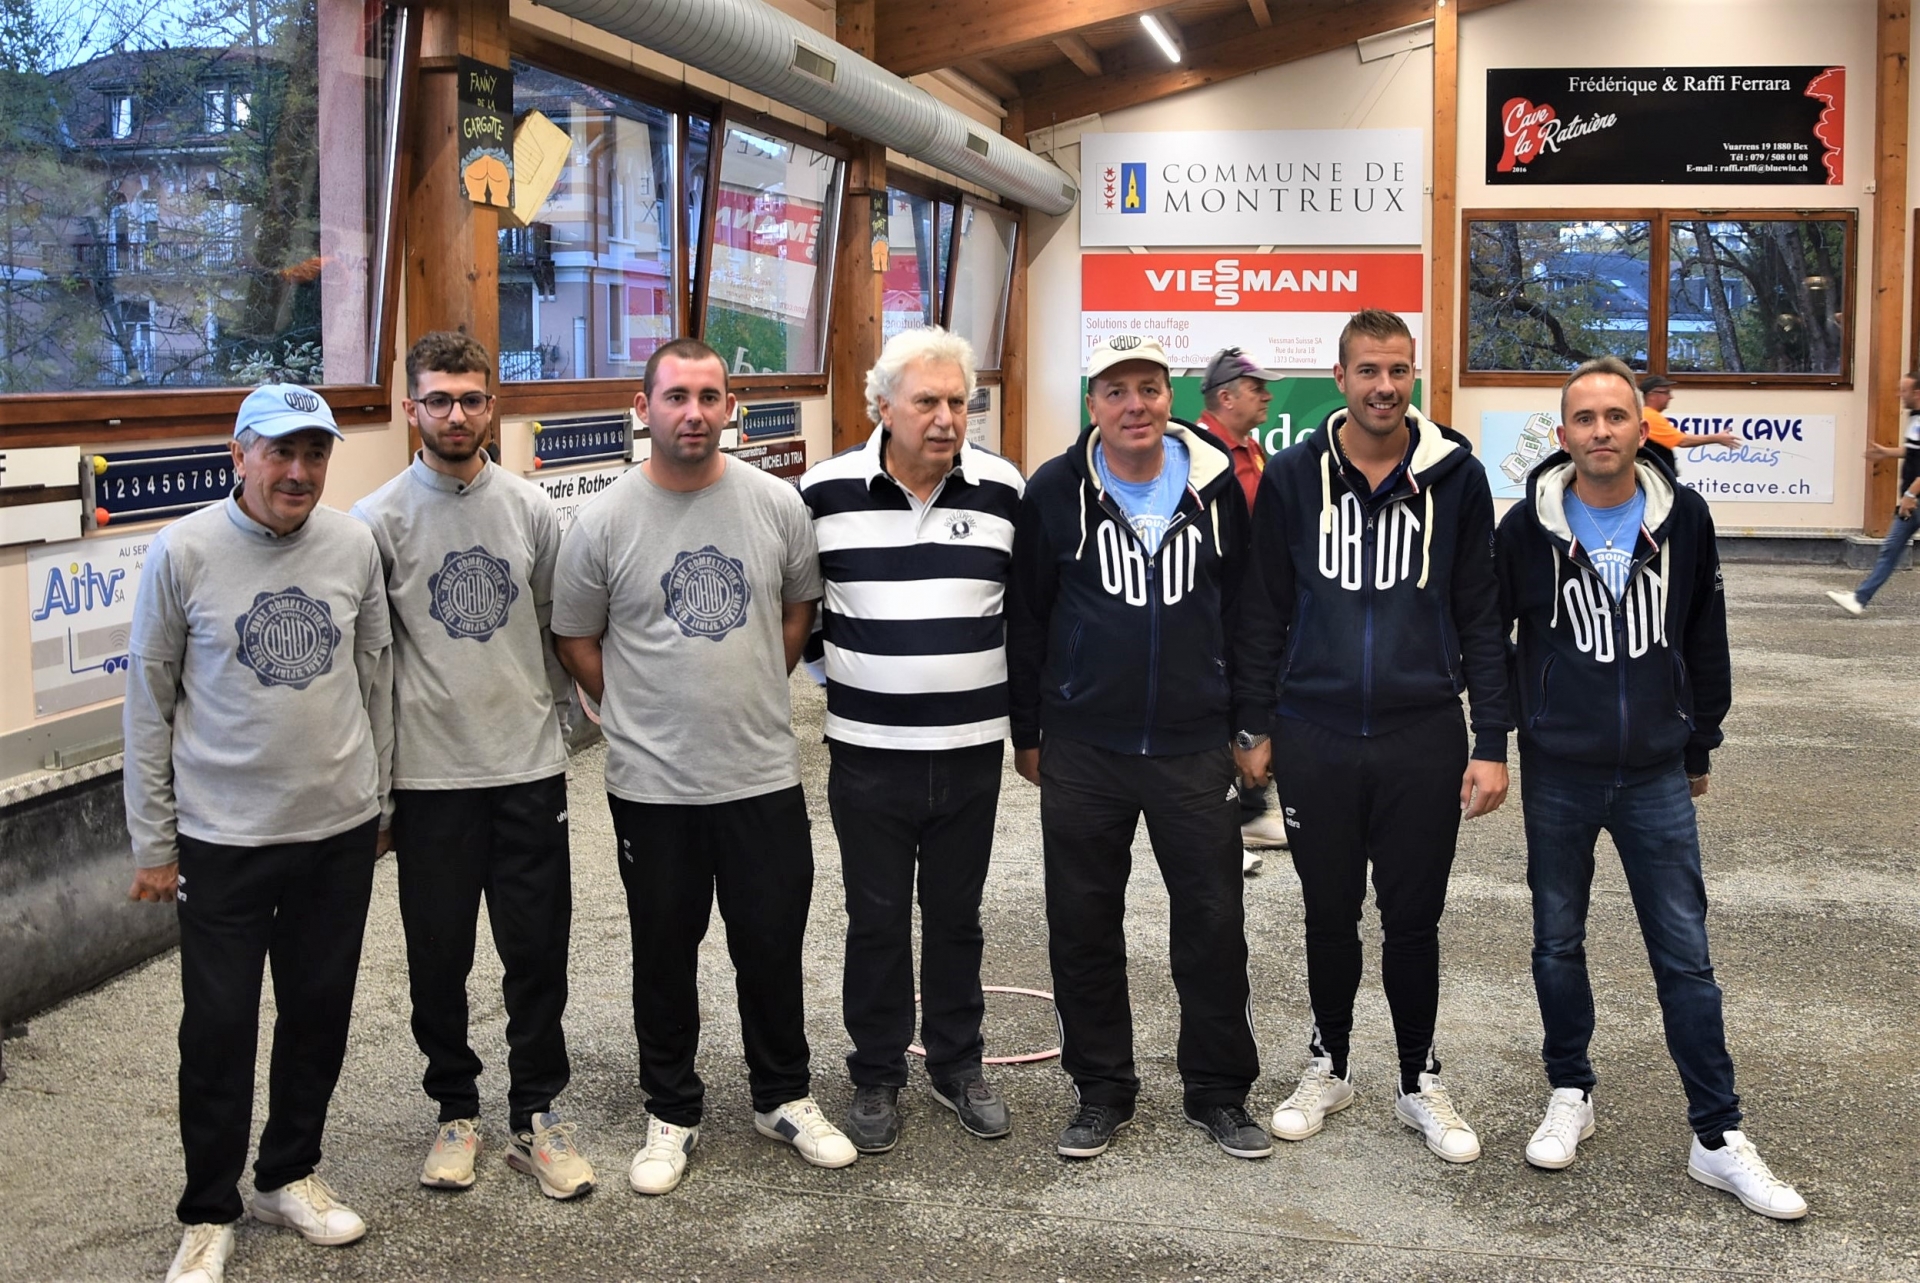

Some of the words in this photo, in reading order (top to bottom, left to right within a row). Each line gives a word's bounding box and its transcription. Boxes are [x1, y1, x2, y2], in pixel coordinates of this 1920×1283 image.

[470, 72, 498, 95] FANNY
[1568, 76, 1657, 96] Frédérique
[1663, 76, 1679, 92] &
[1683, 76, 1726, 92] Raffi
[1730, 76, 1791, 92] Ferrara
[1504, 101, 1549, 137] Cave
[1514, 129, 1533, 156] la
[1537, 112, 1617, 154] Ratinière
[1750, 153, 1765, 161] 079
[1771, 153, 1785, 161] 508
[1787, 153, 1796, 161] 01
[1798, 153, 1808, 161] 08
[1162, 162, 1343, 183] COMMUNE
[1365, 162, 1405, 182] DE
[1163, 188, 1405, 213] MONTREUX
[1144, 259, 1358, 307] VIESSMANN
[1086, 317, 1128, 329] Solutions
[1130, 318, 1141, 329] de
[1144, 317, 1190, 331] chauffage
[1175, 335, 1189, 348] 00
[1742, 418, 1804, 442] CAVE
[761, 454, 783, 470] MICHEL
[103, 480, 109, 499] 1
[117, 479, 125, 498] 2
[132, 477, 140, 496] 3
[147, 475, 156, 494] 4
[162, 474, 170, 493] 5
[177, 472, 185, 491] 6
[191, 471, 198, 490] 7
[205, 469, 213, 488] 8
[219, 468, 227, 486] 9
[1677, 477, 1810, 494] etitecave.ch
[119, 547, 131, 558] AU
[114, 589, 125, 603] SA
